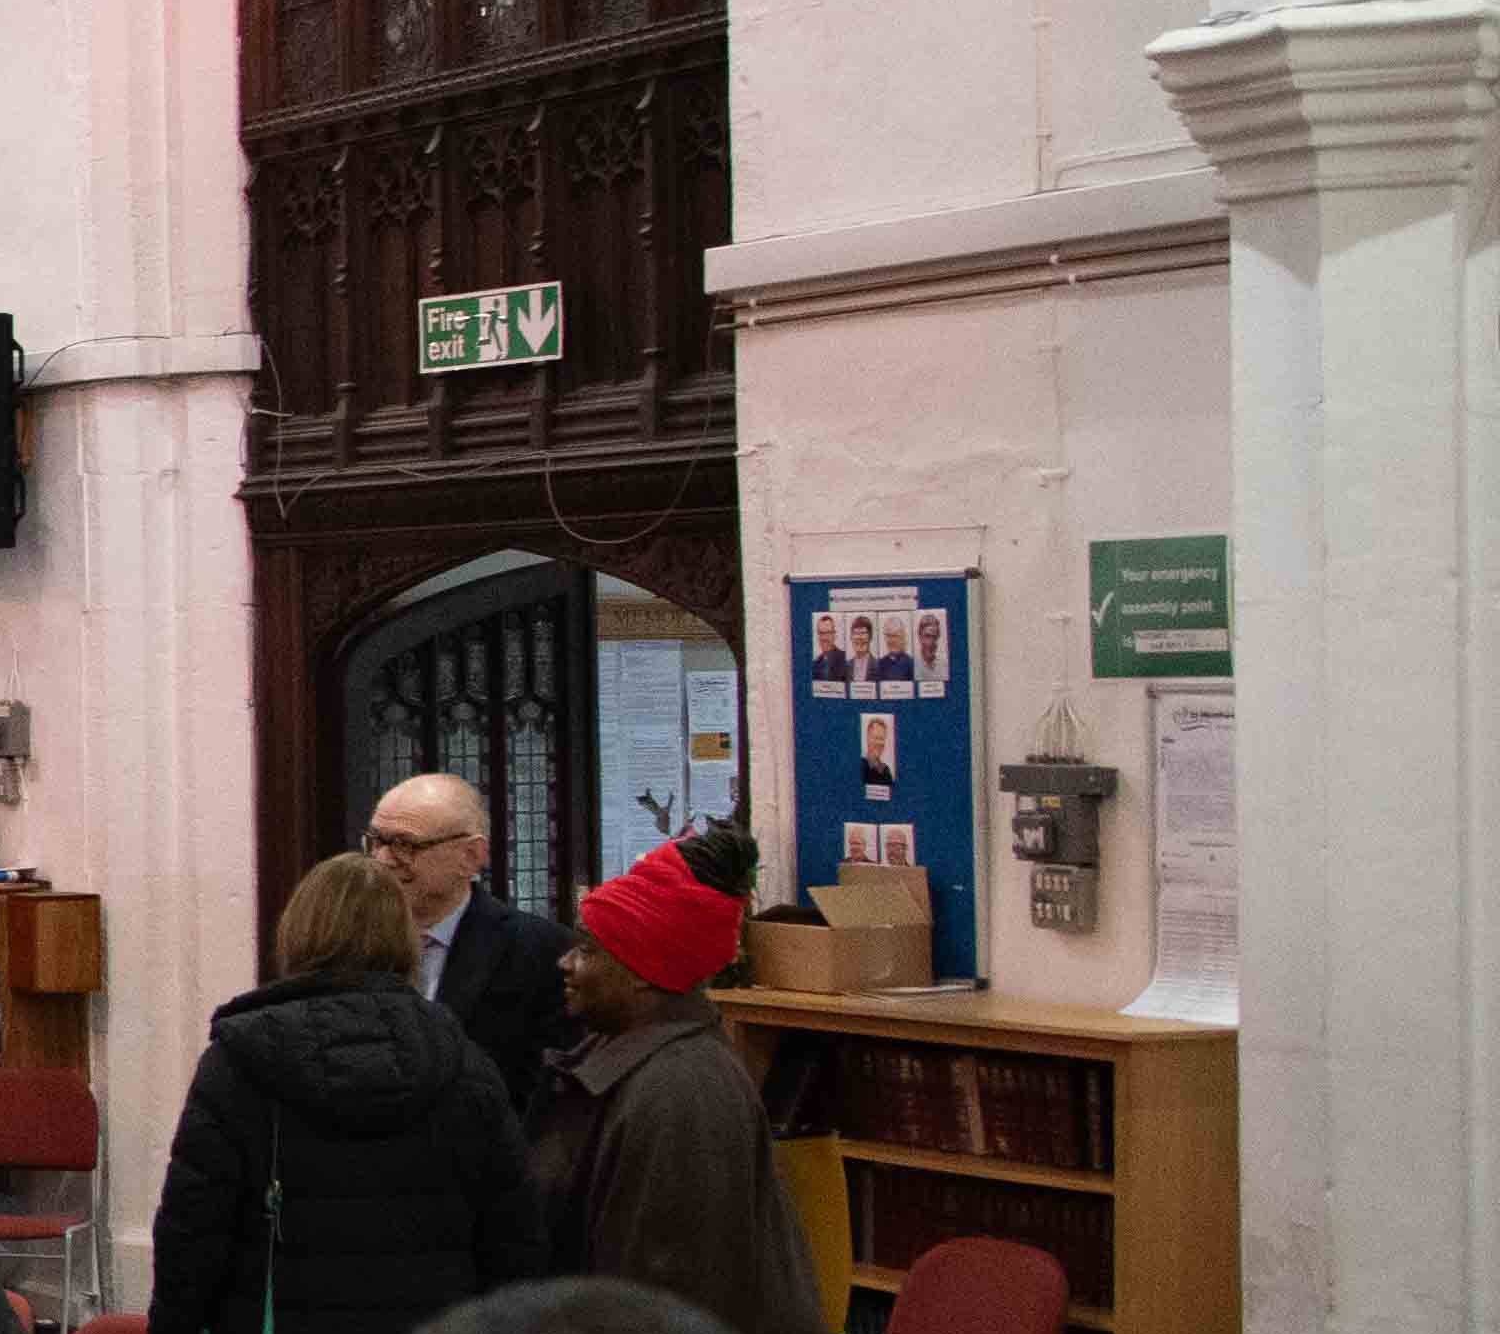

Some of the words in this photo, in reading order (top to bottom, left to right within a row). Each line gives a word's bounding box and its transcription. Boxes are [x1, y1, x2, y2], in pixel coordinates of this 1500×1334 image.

[426, 306, 468, 333] Fire
[427, 334, 466, 361] exit
[1121, 568, 1147, 582] Your
[1150, 568, 1219, 585] emergency
[1121, 598, 1177, 618] assembly
[1180, 598, 1213, 615] point
